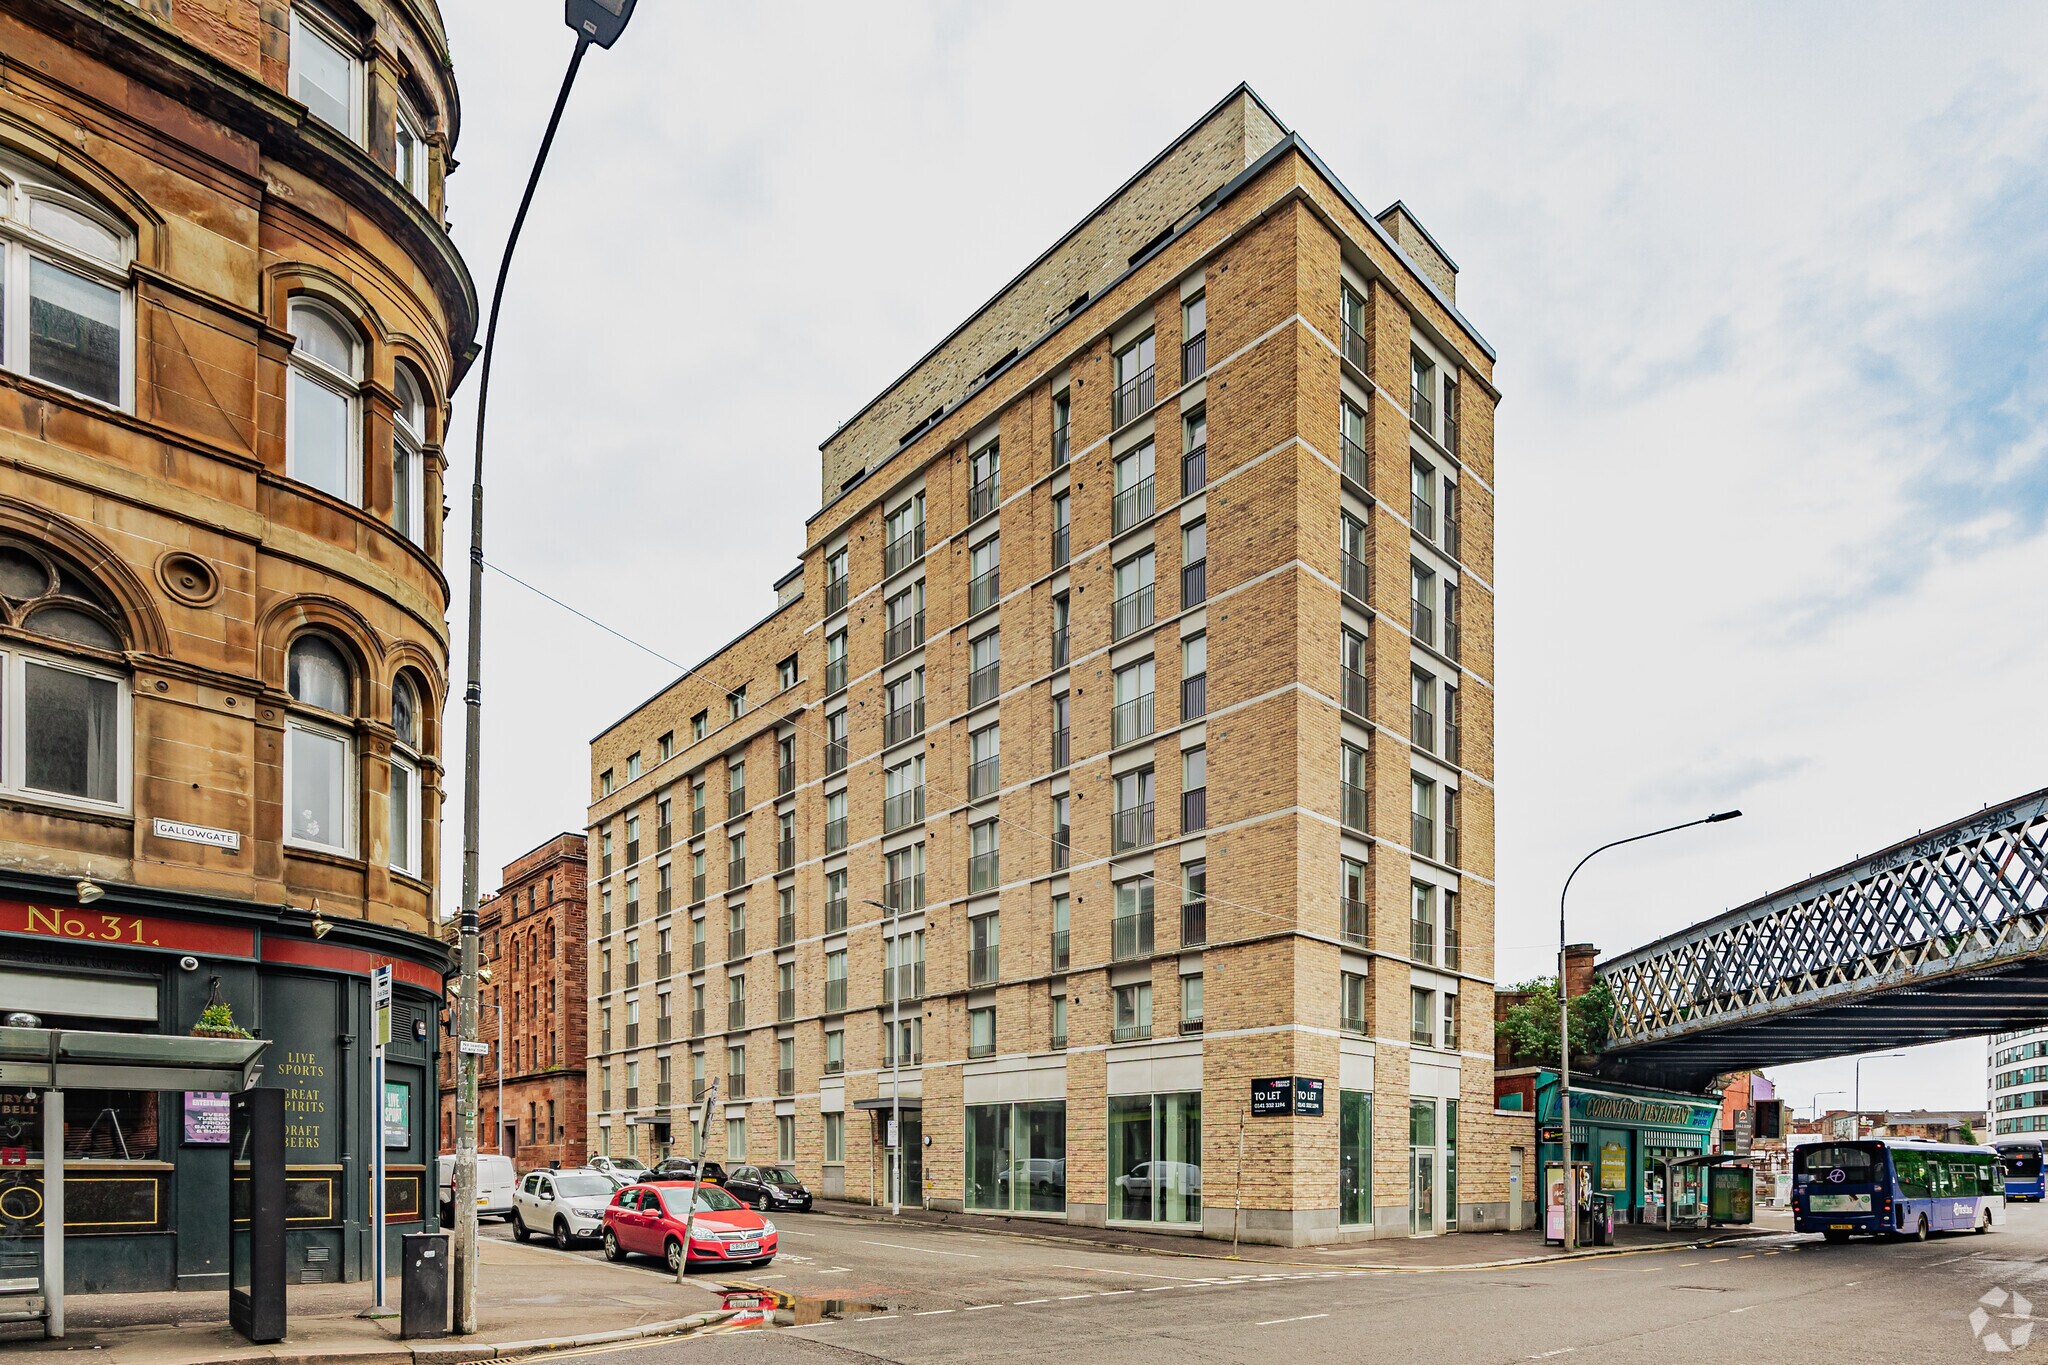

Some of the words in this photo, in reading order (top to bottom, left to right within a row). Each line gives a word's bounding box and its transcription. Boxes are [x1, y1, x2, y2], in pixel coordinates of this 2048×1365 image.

[160, 824, 234, 843] GALLOWGATE
[288, 1052, 315, 1064] LIVE
[278, 1064, 324, 1077] SPORTS
[1254, 1092, 1265, 1101] TO
[1267, 1091, 1281, 1100] LET
[1297, 1091, 1306, 1100] TO
[1307, 1091, 1317, 1101] LET
[2, 1105, 38, 1114] BELL
[284, 1100, 325, 1113] PIRITS
[1585, 1098, 1643, 1120] CORONATION
[1643, 1103, 1692, 1124] RESTAURANT
